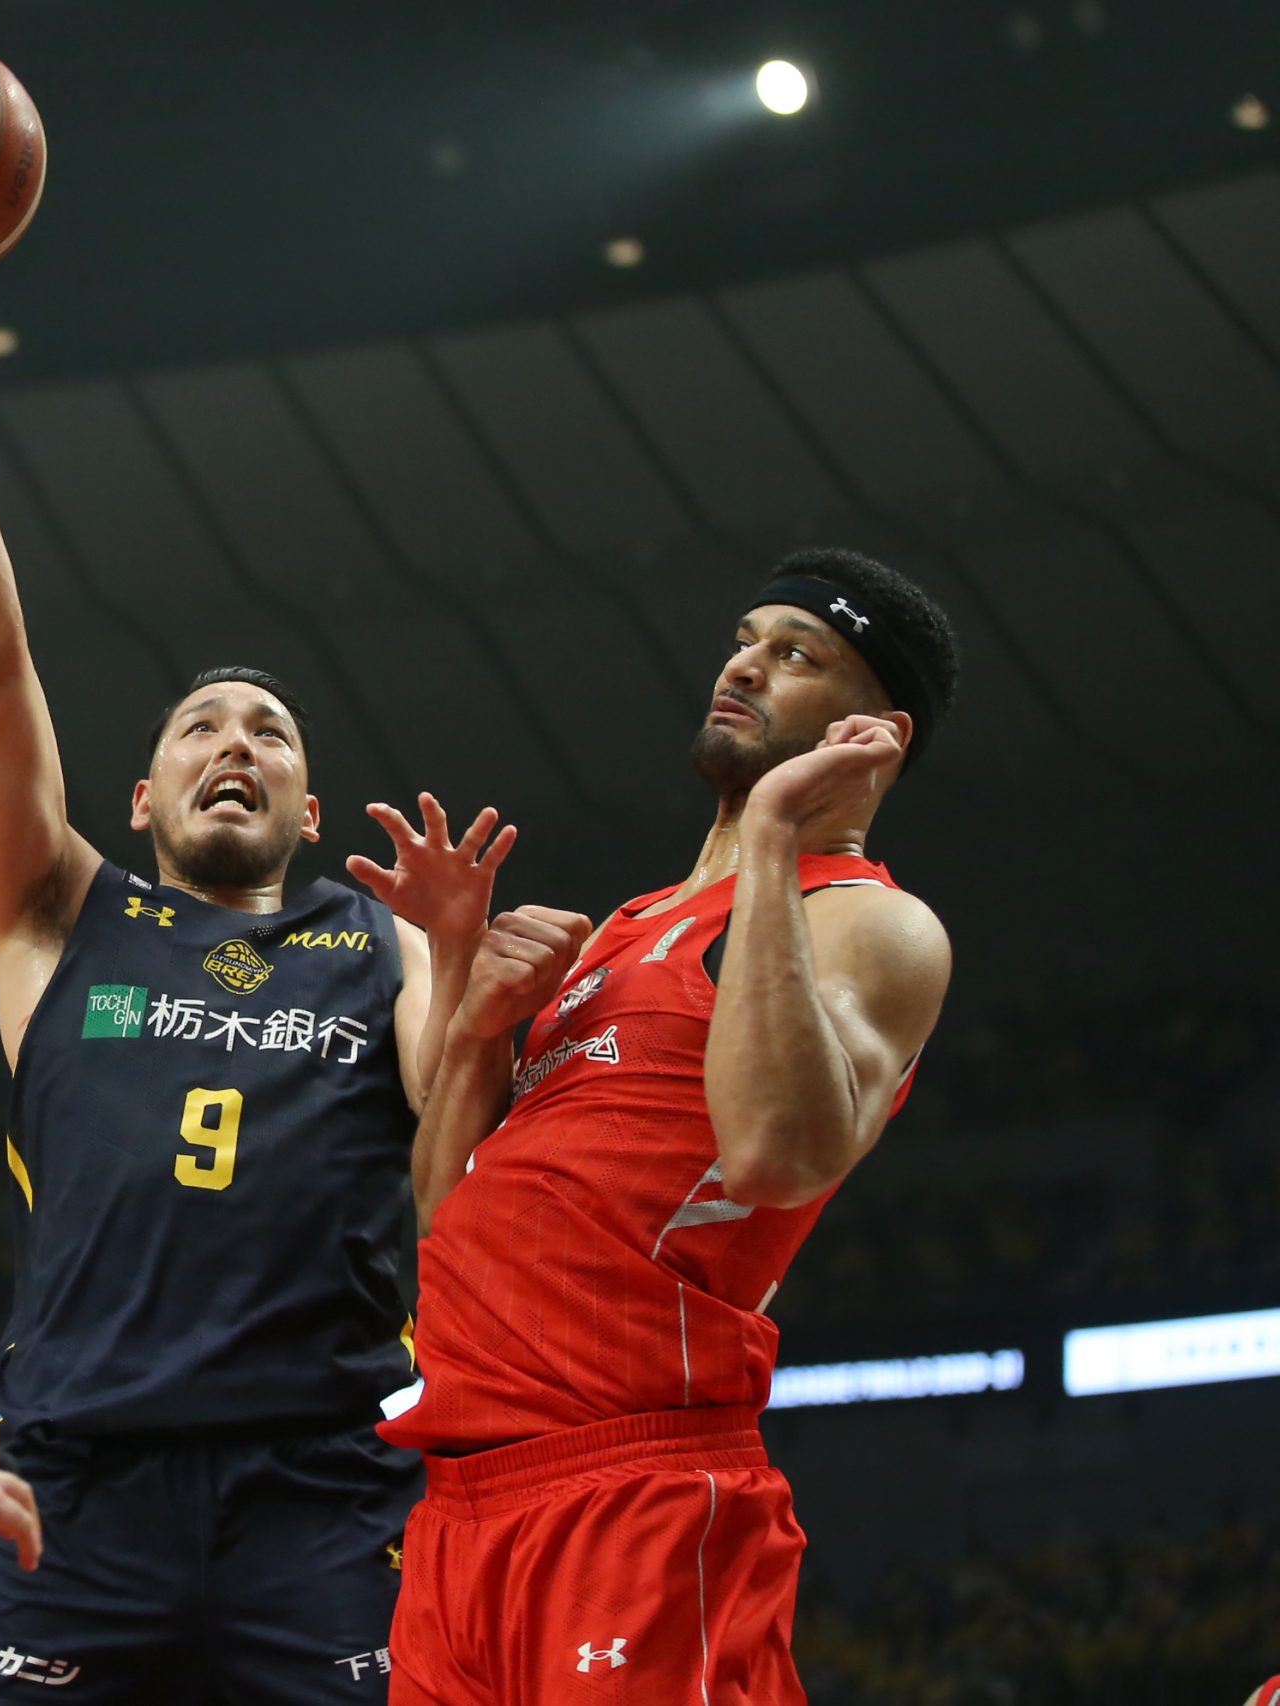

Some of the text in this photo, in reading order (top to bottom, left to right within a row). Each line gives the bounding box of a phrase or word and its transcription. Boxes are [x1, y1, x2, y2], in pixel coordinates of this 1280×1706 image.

[280, 931, 370, 952] MANI
[147, 993, 368, 1064] 栃木銀行
[174, 1087, 245, 1191] 9
